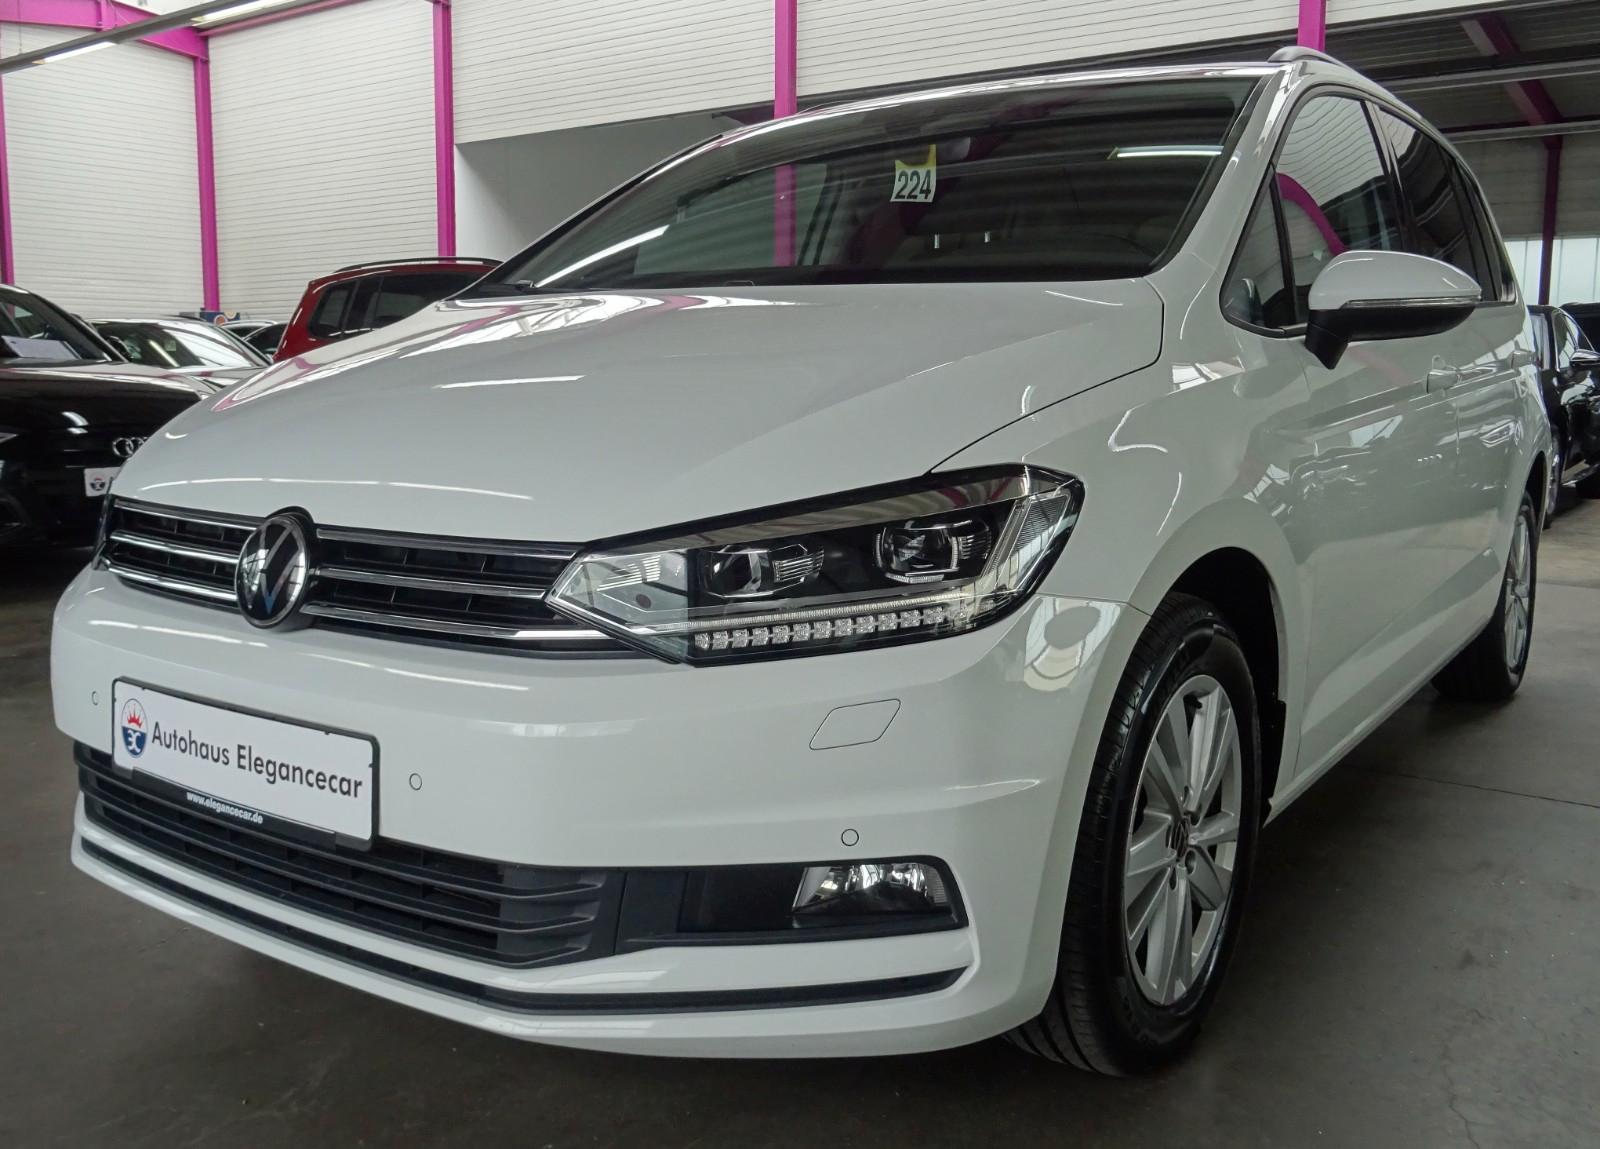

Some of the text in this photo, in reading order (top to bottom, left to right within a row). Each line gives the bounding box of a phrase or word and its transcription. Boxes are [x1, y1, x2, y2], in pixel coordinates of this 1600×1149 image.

[894, 169, 932, 200] 224
[152, 721, 363, 798] Autohaus Elegancecar
[186, 791, 264, 825] www.elegancecar.de
